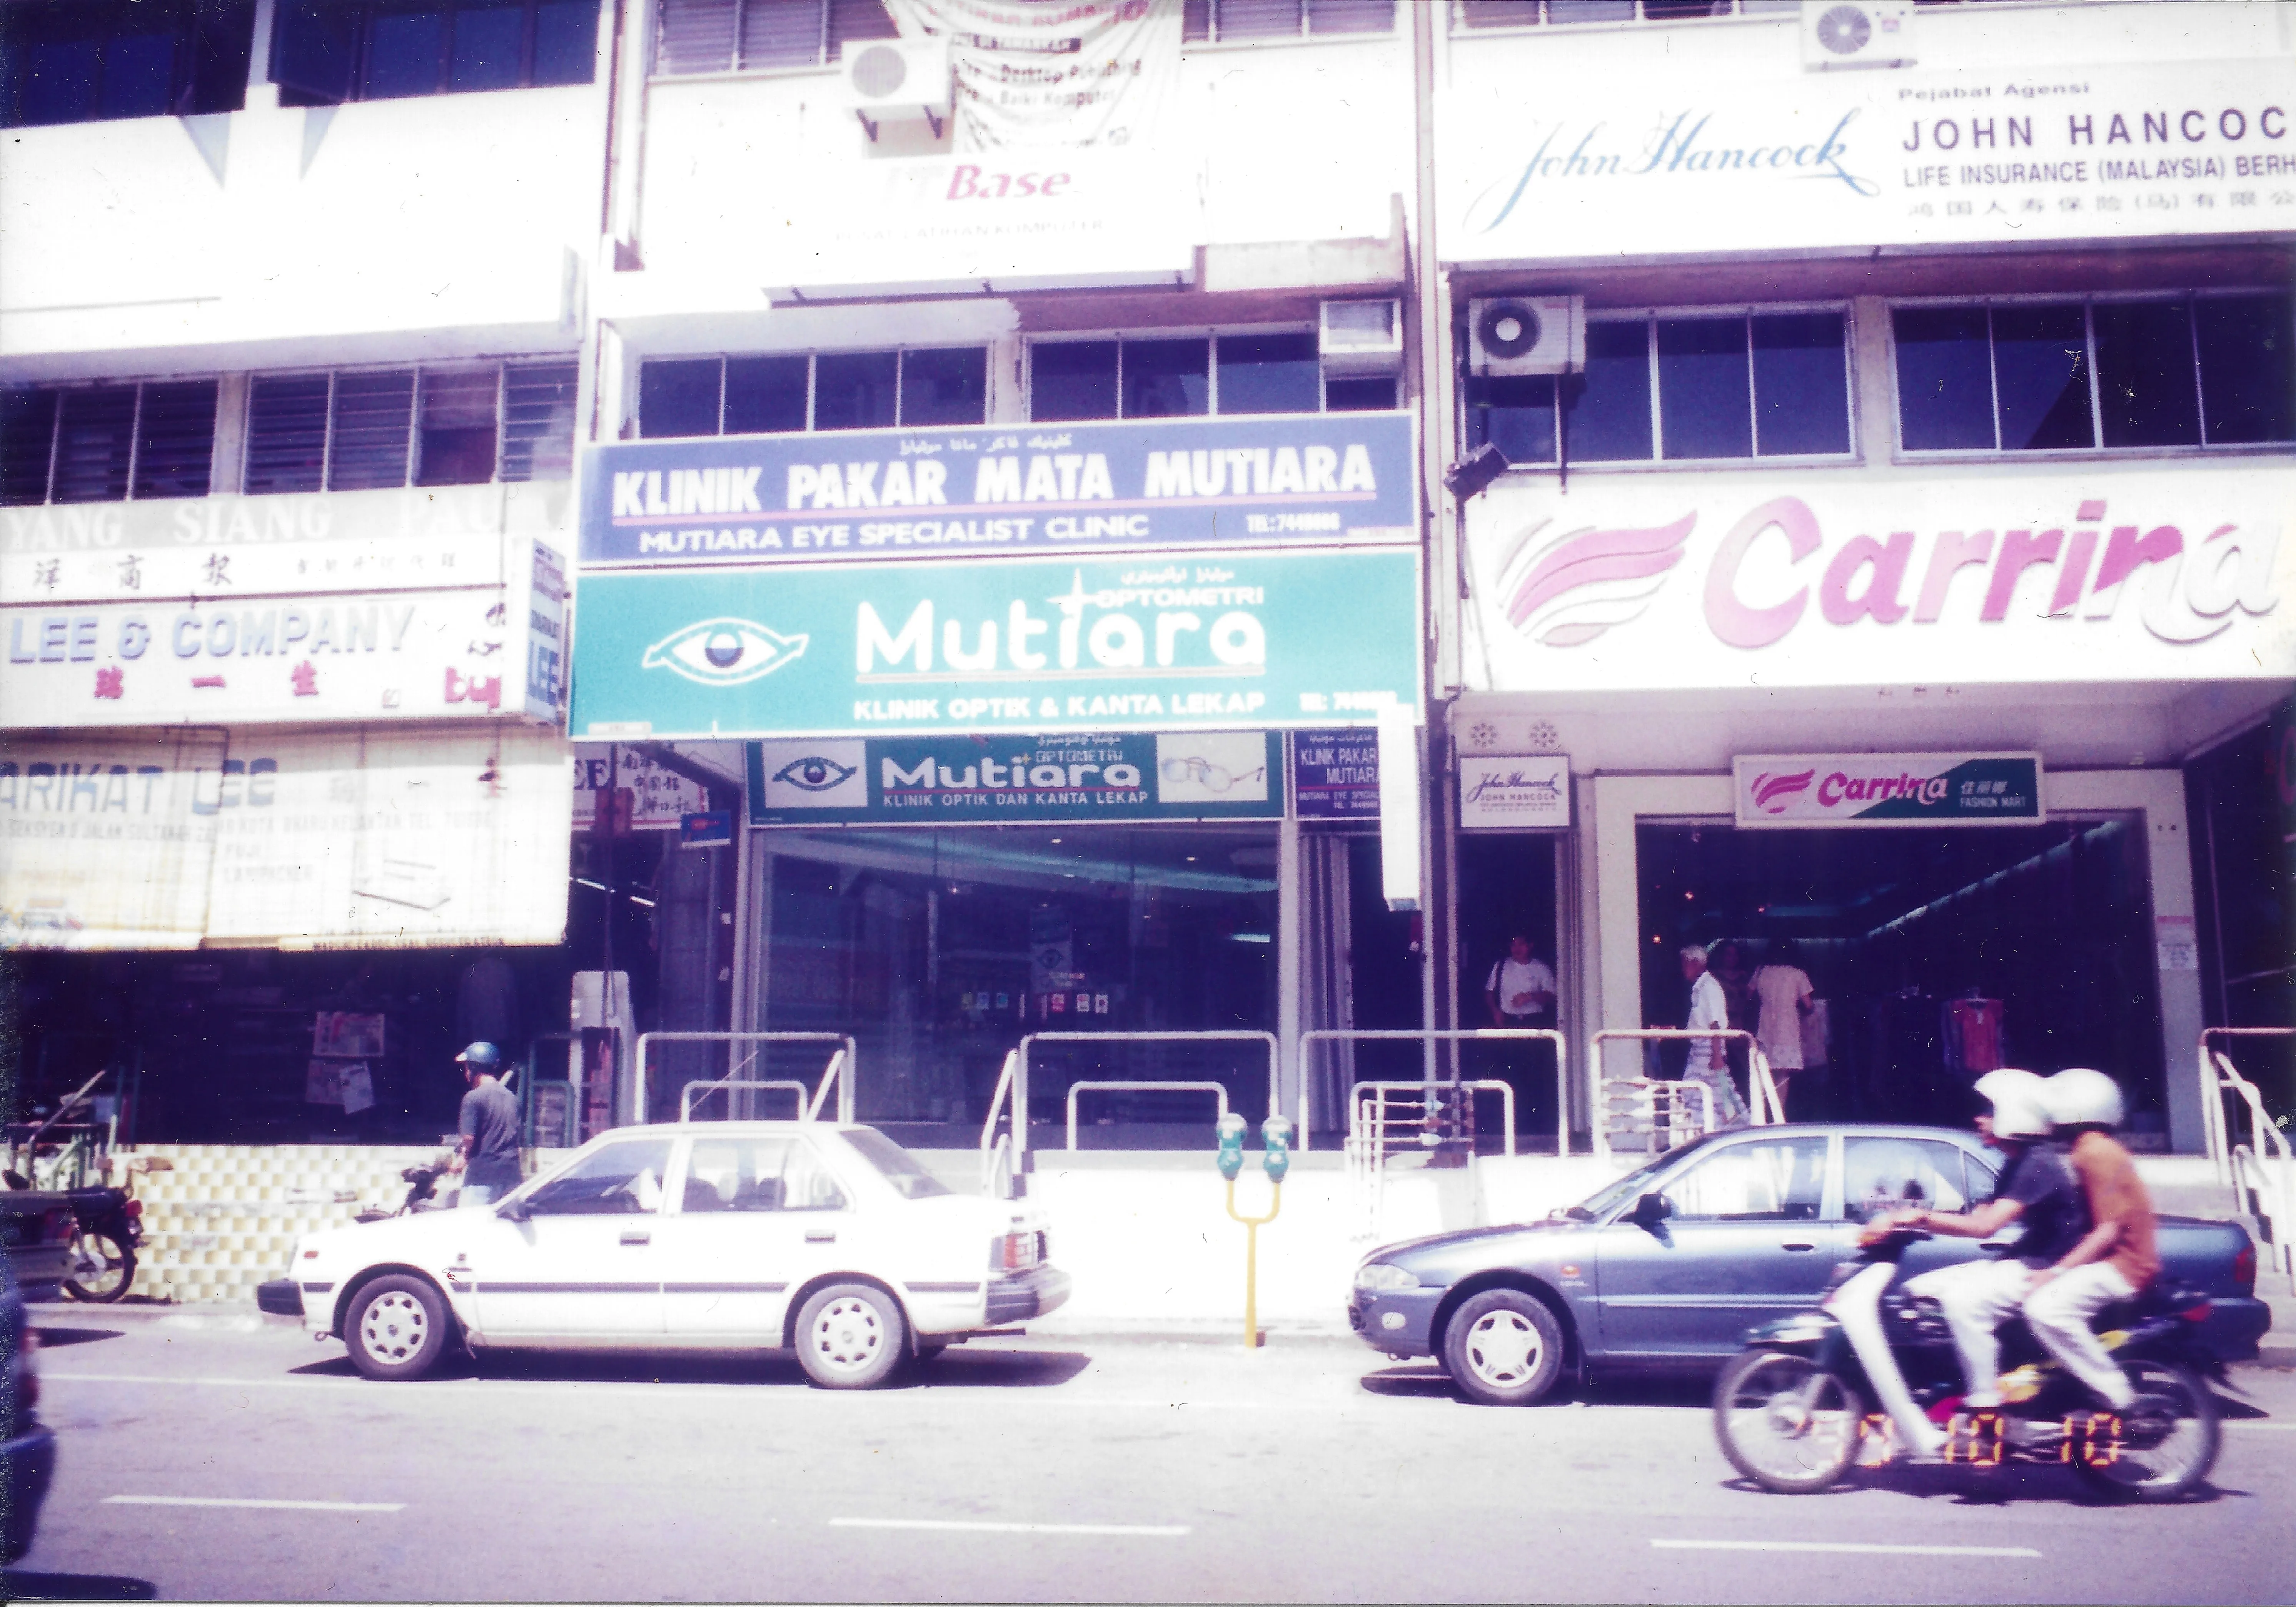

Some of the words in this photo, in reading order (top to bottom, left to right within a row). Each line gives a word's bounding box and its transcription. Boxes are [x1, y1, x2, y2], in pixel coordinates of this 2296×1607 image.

[1897, 86, 1991, 102] Pejabat
[2004, 82, 2090, 99] Agensi
[1903, 116, 2034, 152] JOHN
[2068, 106, 2288, 146] HANCOC
[945, 162, 1072, 201] Base
[1462, 119, 1621, 236] John
[1620, 106, 1881, 198] Hancock
[1904, 165, 1951, 189] LIFE
[1960, 161, 2088, 185] INSURANCE
[2097, 155, 2226, 182] (MALAYSIA)
[2235, 153, 2296, 177] BERH
[614, 466, 764, 517] KLINIK
[788, 459, 948, 510] PAKAR
[974, 453, 1115, 503] MATA
[1143, 444, 1377, 498] MUTIARA
[8, 506, 122, 551] YANG
[174, 496, 332, 545] SIANG
[639, 526, 783, 553] MUTIARA
[792, 524, 849, 549] EYE
[858, 518, 1035, 546] SPECIALIST
[1045, 514, 1150, 540] CLINIC
[1702, 494, 2281, 651] Carrina
[1097, 586, 1264, 608] OPTOMETRI
[10, 616, 99, 664] LEE
[118, 620, 151, 660] &
[172, 606, 416, 659] COMPANY
[856, 595, 1266, 673] Mutiara
[853, 699, 939, 722] KLINIK
[948, 697, 1031, 720] OPTIK
[1040, 697, 1056, 718] &
[1067, 694, 1165, 717] KANTA
[1171, 691, 1265, 715] LEKAP
[881, 754, 1141, 789] Mutiara
[1036, 750, 1124, 763] OPTOMETRI
[1301, 748, 1335, 766] KLINIK
[1338, 748, 1379, 765] PAKAR
[192, 757, 278, 816] LEE
[883, 794, 933, 807] KLINIK
[941, 793, 988, 807] OPTIK
[996, 793, 1028, 806] DAN
[1035, 791, 1089, 805] KANTA
[1096, 790, 1148, 804] LEKAP
[1817, 771, 1948, 808] Carrina
